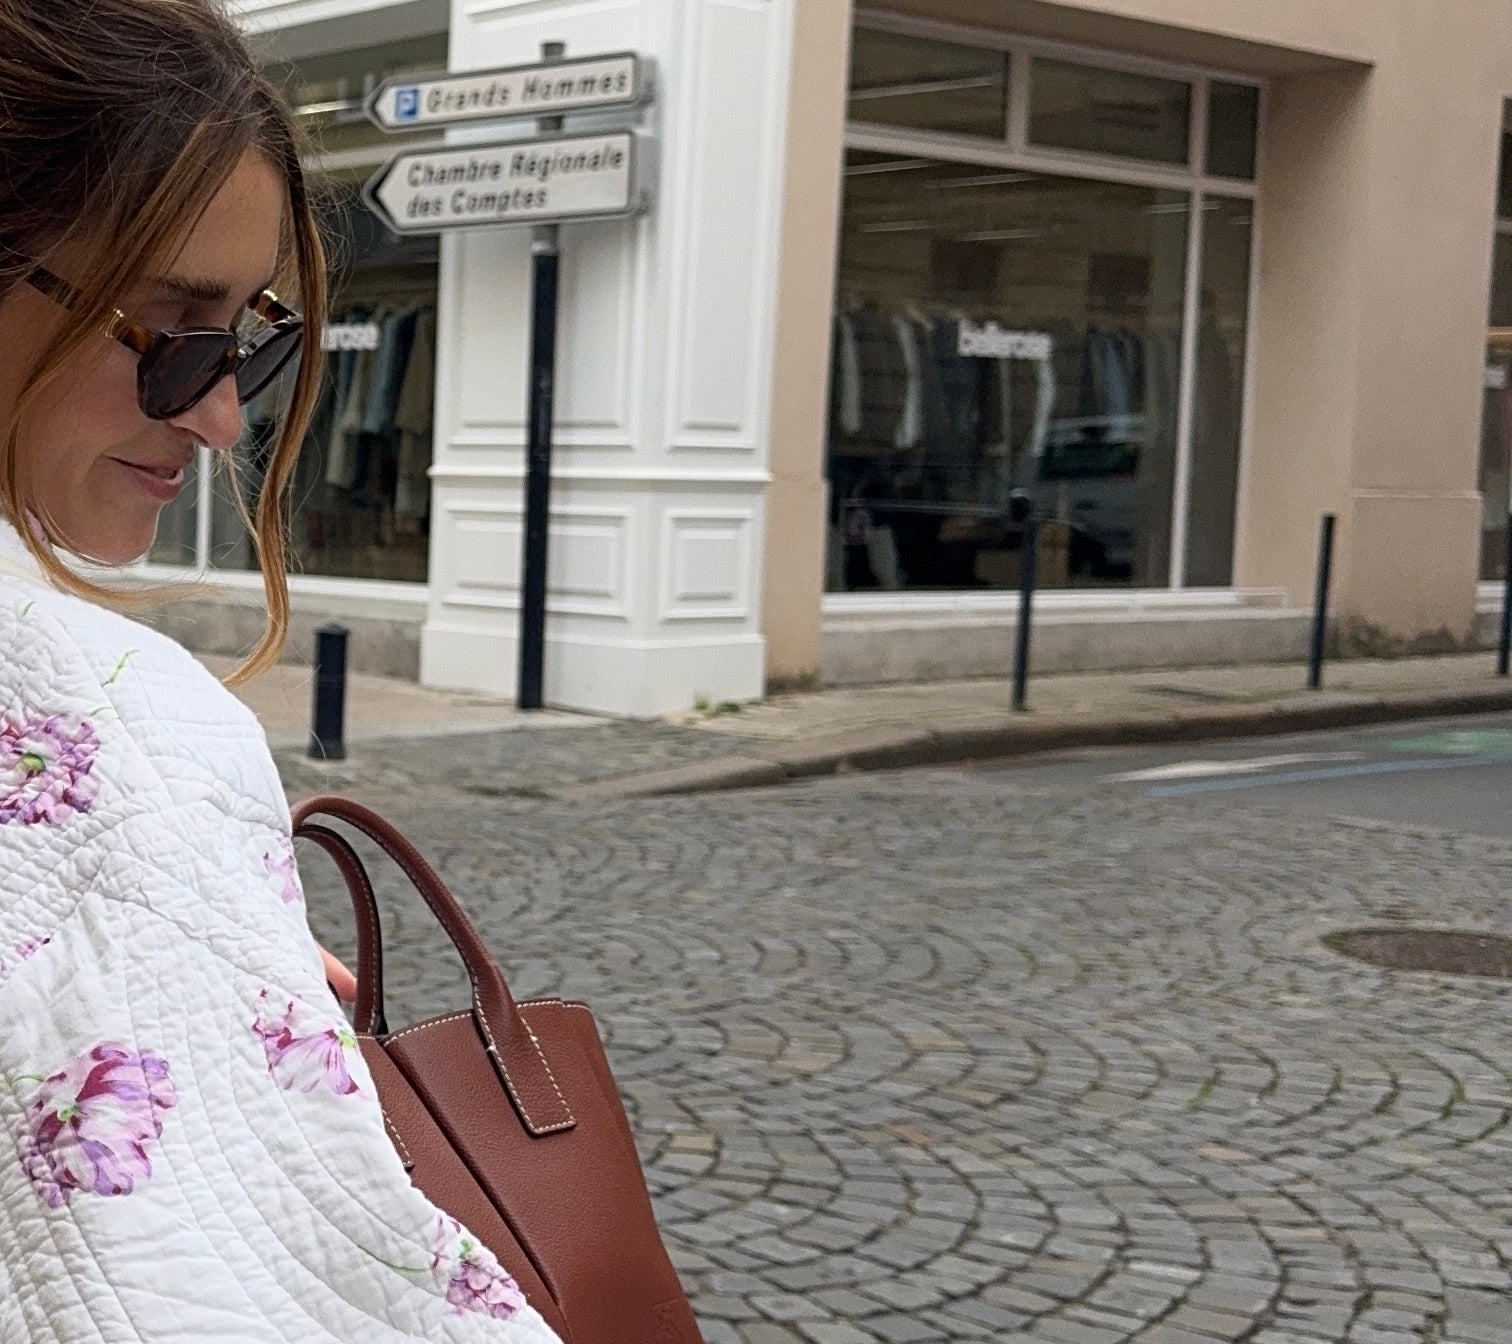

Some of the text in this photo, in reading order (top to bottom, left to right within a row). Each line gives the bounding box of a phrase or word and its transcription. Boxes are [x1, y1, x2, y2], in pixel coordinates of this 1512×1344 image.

[427, 80, 510, 113] Grands
[521, 70, 627, 103] Hommes
[407, 144, 625, 188] Chambre Régionale
[406, 186, 549, 219] des Comptes
